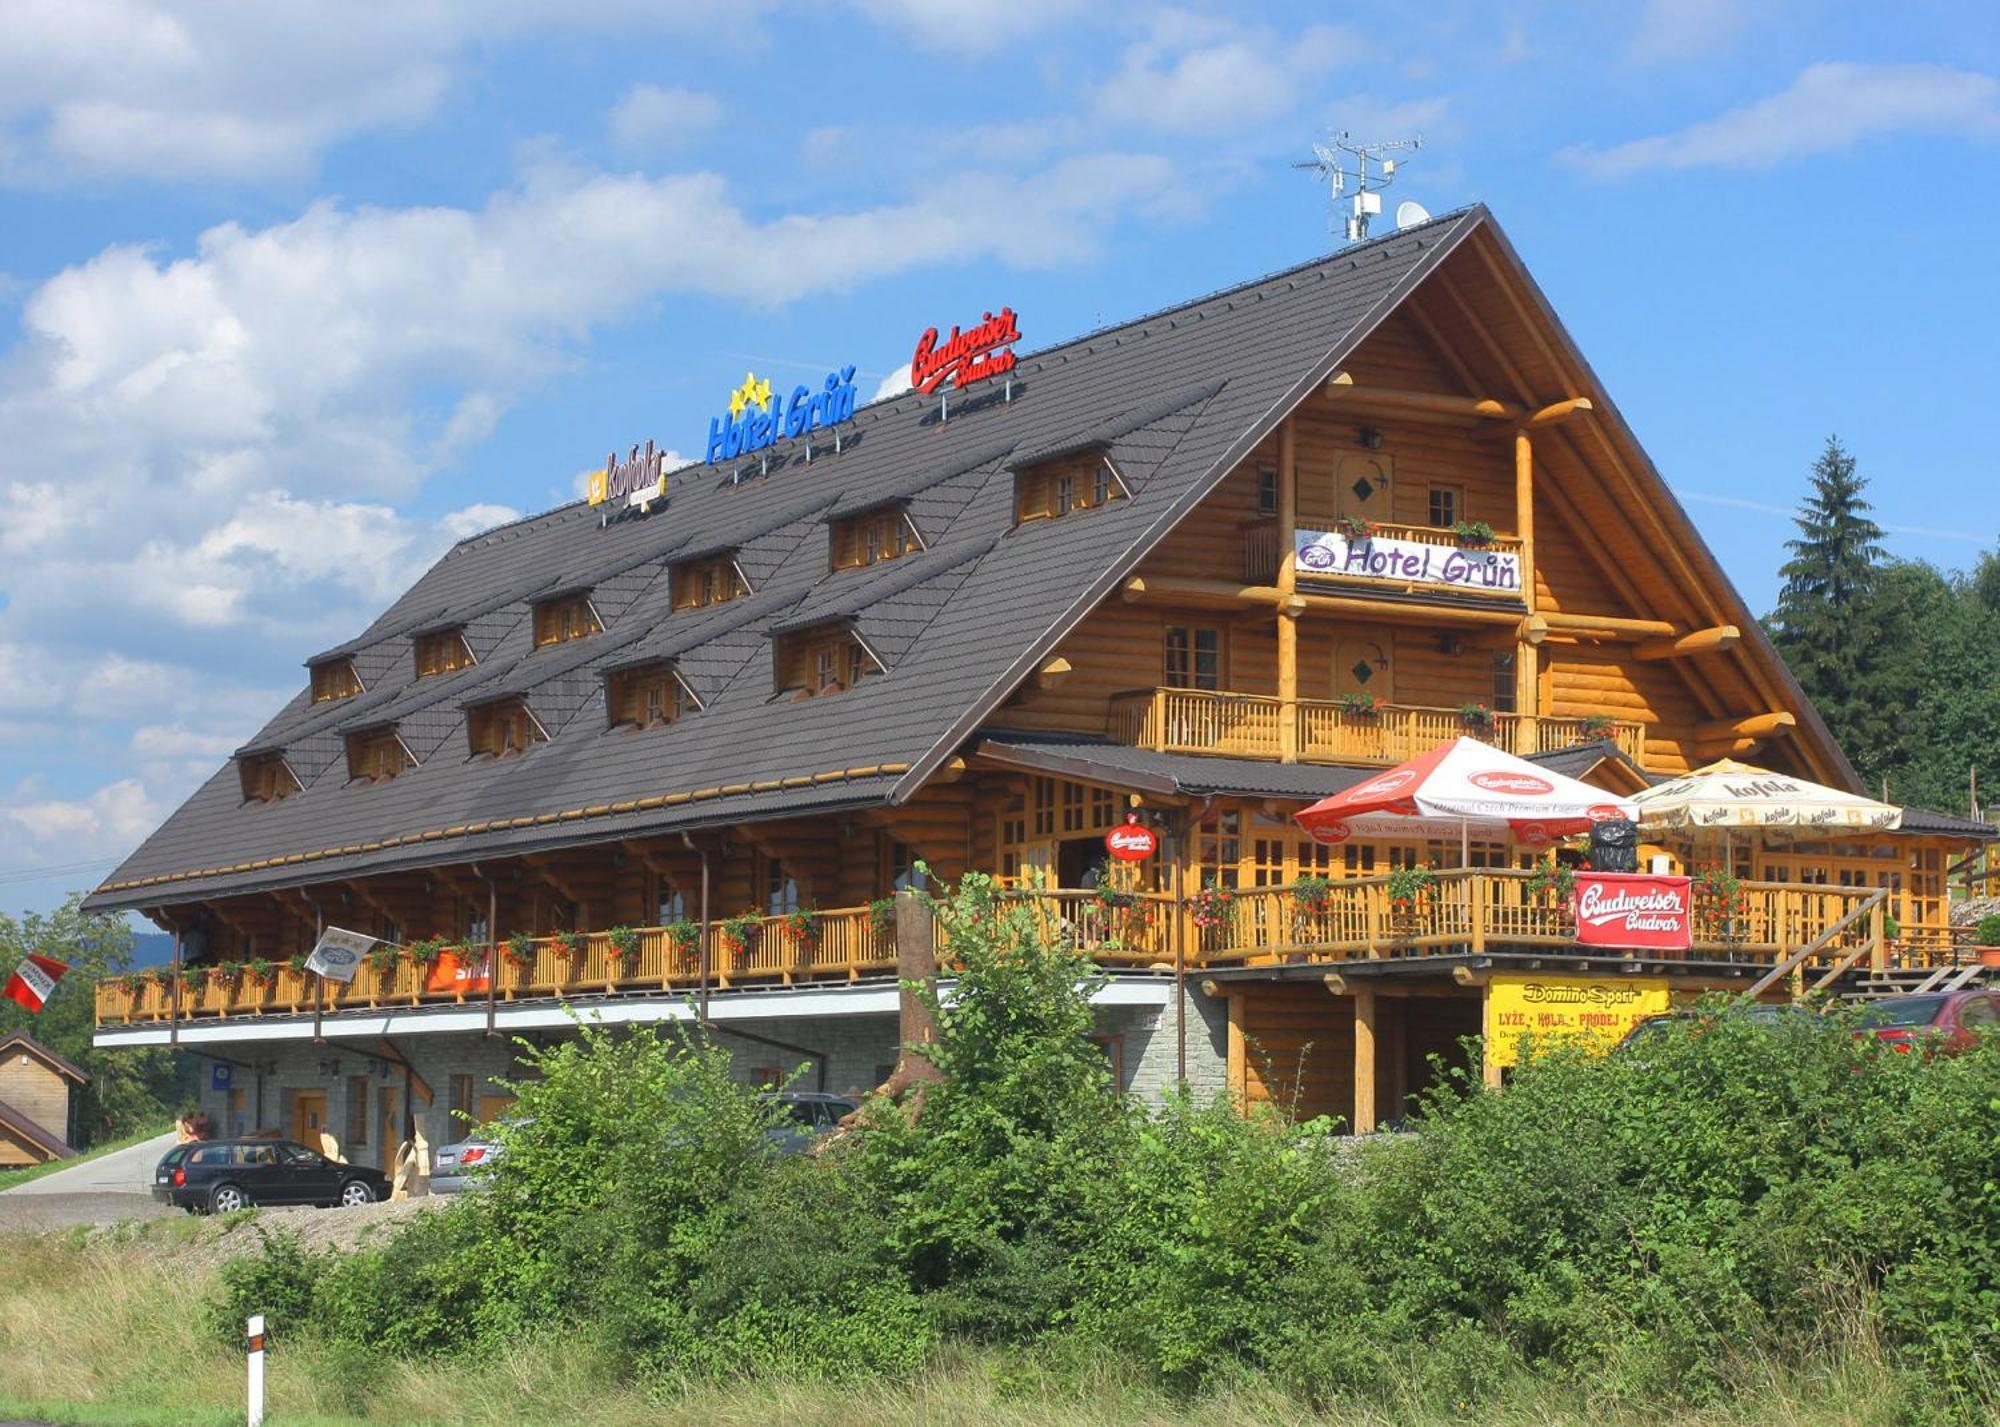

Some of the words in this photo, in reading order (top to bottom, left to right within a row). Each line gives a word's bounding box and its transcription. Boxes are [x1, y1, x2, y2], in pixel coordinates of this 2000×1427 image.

[911, 306, 1022, 391] Budweiser
[705, 393, 782, 465] Hotel
[1343, 539, 1430, 578] Hotel
[1443, 551, 1515, 588] Grůň
[1723, 780, 1800, 799] kofola
[1703, 808, 1729, 824] kofola
[1765, 807, 1790, 824] kofola
[1811, 808, 1837, 825] kofola
[1581, 883, 1684, 923] Budweiser
[1625, 909, 1681, 931] Budvar
[1524, 984, 1588, 1003] Domino
[1588, 984, 1641, 1008] Sport
[1498, 1010, 1526, 1026] LYŽE
[1579, 1013, 1619, 1026] PRODEJ
